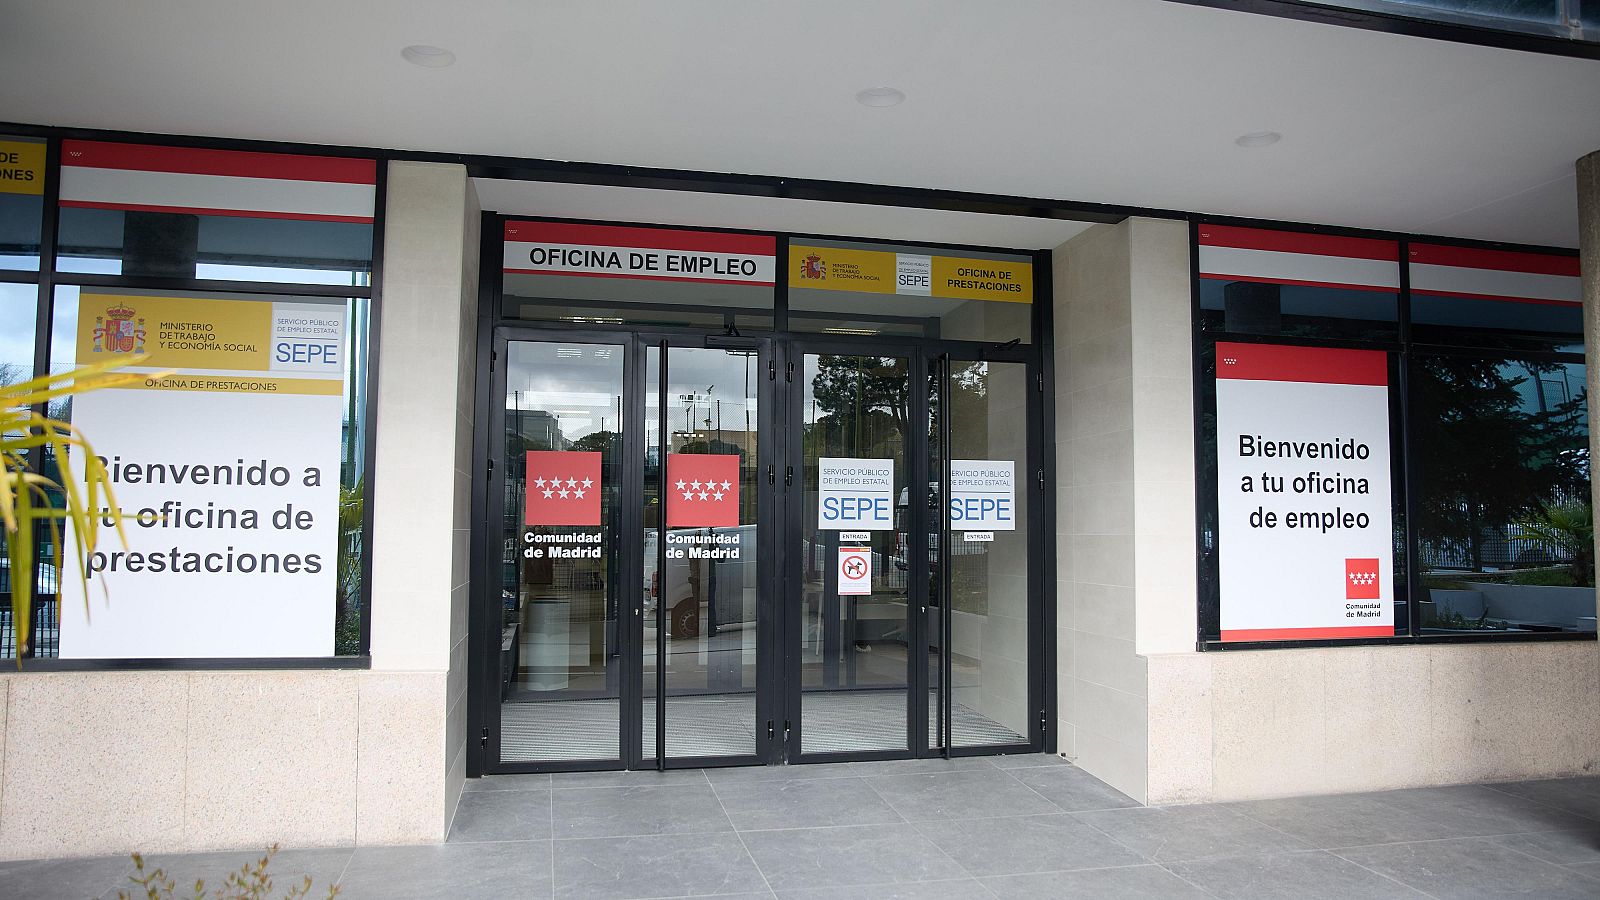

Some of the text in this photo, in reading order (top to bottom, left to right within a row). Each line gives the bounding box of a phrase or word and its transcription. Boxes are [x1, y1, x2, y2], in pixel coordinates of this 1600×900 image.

[0, 152, 19, 164] DE
[0, 169, 34, 181] NES
[529, 247, 757, 276] OFICINA DE EMPLEO
[957, 267, 1012, 280] OFICINA DE
[899, 274, 929, 287] SEPE
[947, 279, 1022, 293] PRESTACIONES
[160, 322, 213, 331] MINISTERIO
[277, 318, 339, 327] SERVICIO PÚBLICO
[160, 332, 216, 342] DE TRABAJO
[168, 341, 221, 351] ECONOMÍA
[224, 344, 257, 352] SOCIAL
[276, 342, 338, 364] SEPE
[145, 379, 277, 391] OFICINA DE PRESTACIONES
[1239, 434, 1370, 460] Bienvenido
[303, 465, 322, 487] a
[823, 468, 890, 477] SERVICIO PÚBLICO
[981, 469, 1010, 477] PÚBLICO
[1241, 471, 1370, 494] a tu oficina
[823, 496, 889, 520] SEPE
[951, 498, 1011, 520] SEPE
[88, 500, 314, 530] u oficina de
[1249, 506, 1370, 533] de empleo
[524, 532, 602, 543] Comunidad
[666, 533, 740, 544] Comunidad
[524, 546, 602, 558] de Madrid
[666, 547, 740, 559] de Madrid
[86, 546, 322, 579] prestaciones
